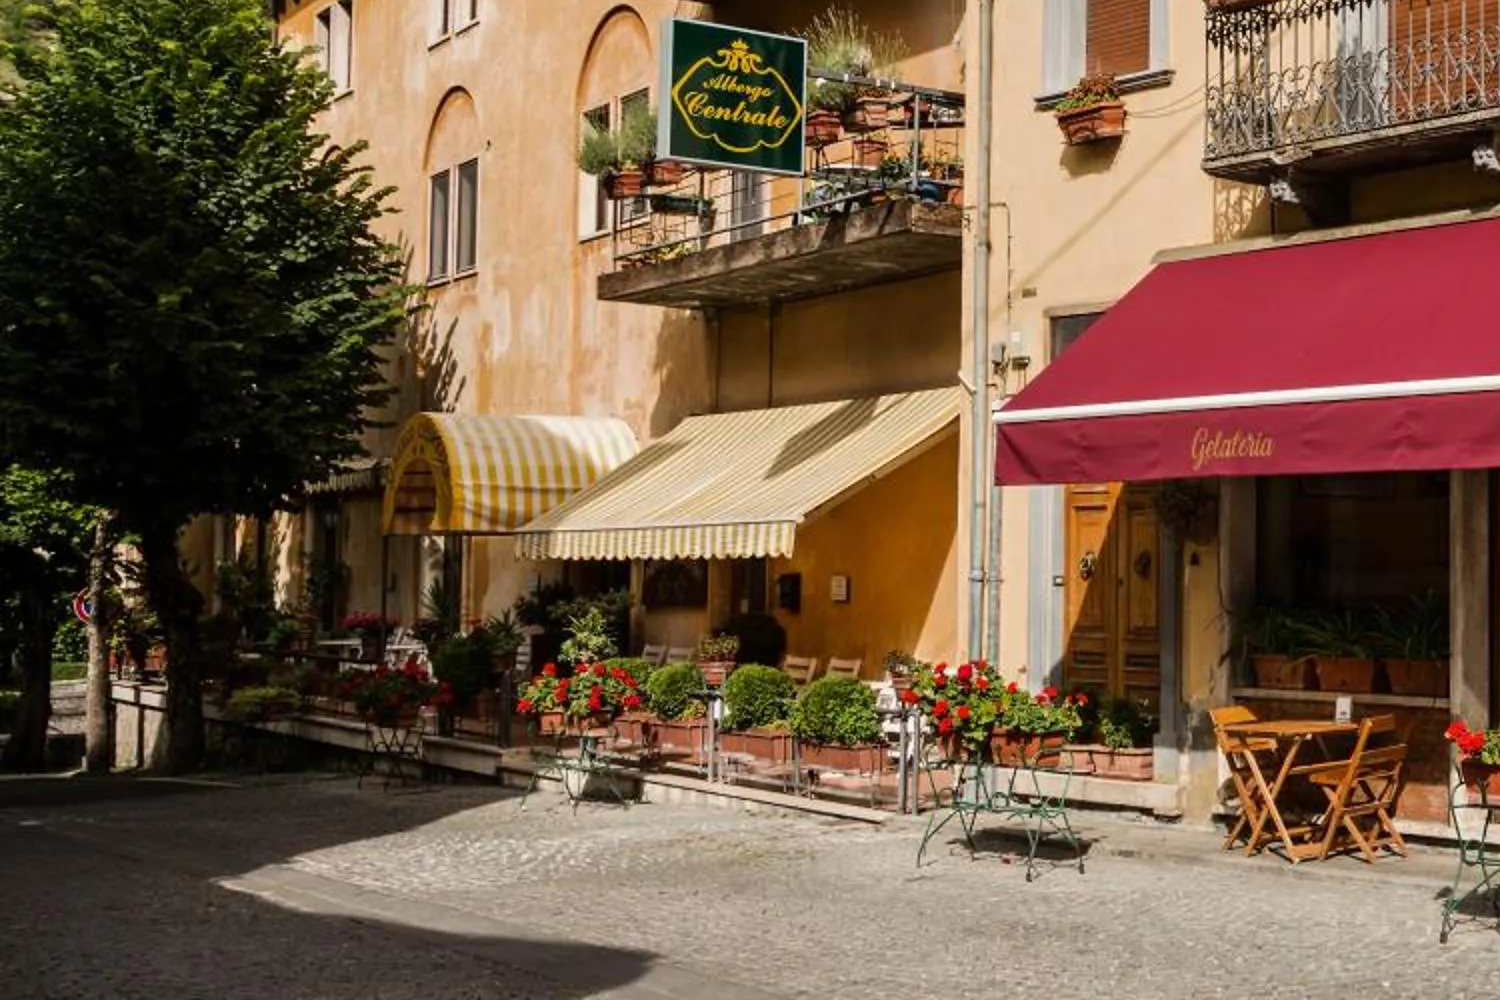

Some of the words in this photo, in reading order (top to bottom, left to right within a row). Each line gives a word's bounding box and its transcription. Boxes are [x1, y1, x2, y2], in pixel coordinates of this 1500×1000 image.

[703, 74, 775, 102] Albergo
[684, 91, 790, 129] Centrale
[1191, 427, 1276, 471] Gelateria
